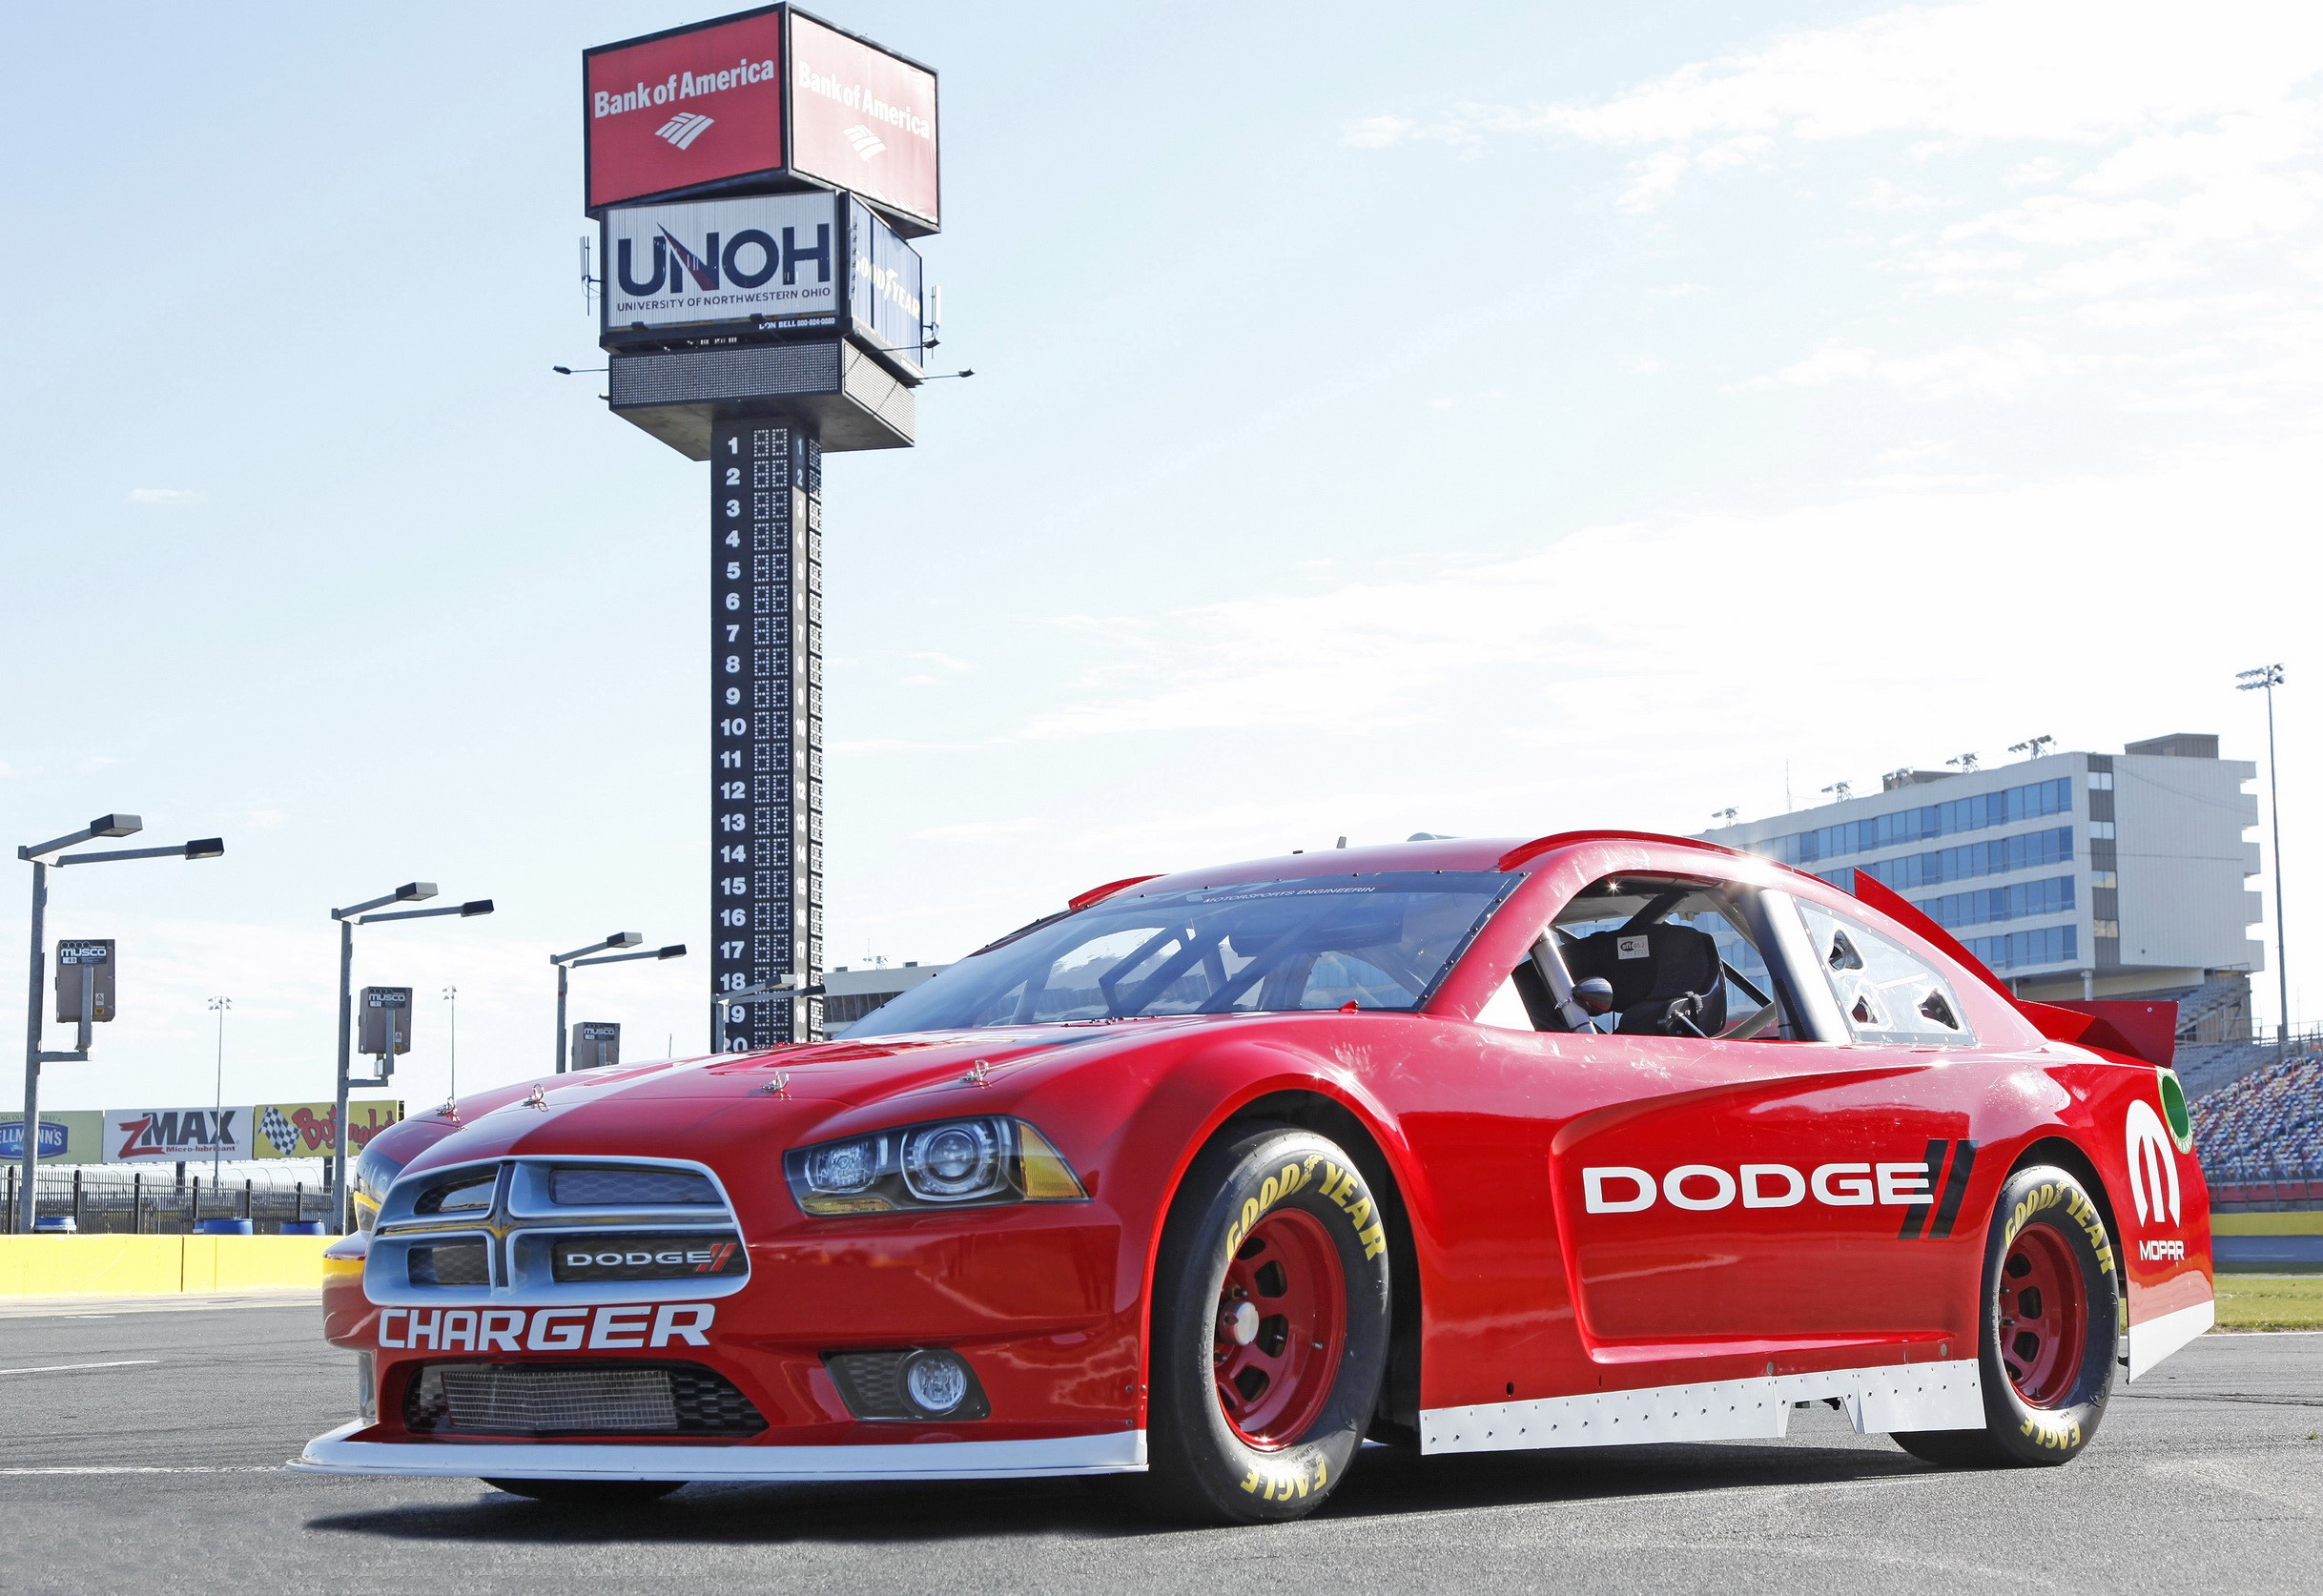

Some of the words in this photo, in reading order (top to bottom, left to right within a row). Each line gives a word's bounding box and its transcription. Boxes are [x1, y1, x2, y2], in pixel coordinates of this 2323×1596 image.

[594, 83, 651, 118] Bank
[653, 73, 677, 105] of
[680, 58, 774, 98] America
[798, 61, 842, 102] Bank
[843, 84, 861, 110] of
[862, 88, 931, 139] America
[617, 222, 831, 297] UNOH
[617, 297, 685, 313] UNIVERSITY
[687, 296, 702, 307] OF
[702, 290, 799, 306] NORTHWESTERN
[801, 287, 832, 299] OHIO
[728, 436, 738, 455] 1
[796, 437, 804, 456] 1
[726, 467, 741, 486] 2
[796, 467, 804, 487] 2
[726, 499, 741, 518] 3
[796, 499, 805, 519] 3
[725, 529, 741, 548] 4
[796, 530, 804, 549] 4
[726, 561, 741, 580] 5
[796, 562, 804, 581] 5
[725, 592, 741, 611] 6
[796, 592, 804, 611] 6
[726, 624, 740, 643] 7
[797, 624, 804, 643] 7
[725, 655, 741, 674] 8
[796, 655, 804, 674] 8
[726, 686, 741, 706] 9
[796, 686, 804, 706] 9
[720, 717, 747, 736] 10
[795, 717, 807, 738] 10
[720, 749, 742, 768] 11
[795, 749, 805, 769] 11
[720, 781, 746, 800] 12
[795, 781, 807, 801] 12
[720, 812, 746, 832] 13
[795, 812, 807, 833] 13
[720, 844, 747, 864] 14
[795, 844, 807, 864] 14
[720, 876, 747, 895] 15
[795, 876, 807, 896] 15
[1203, 890, 1296, 904] MOTORSPORTS
[720, 908, 747, 927] 16
[795, 908, 807, 928] 16
[720, 940, 746, 959] 17
[795, 940, 806, 959] 17
[719, 972, 747, 992] 18
[1582, 1162, 1934, 1214] DODGE
[566, 1250, 712, 1266] DODGE
[2139, 1239, 2185, 1260] MOPAR
[378, 1303, 716, 1352] CHARGER
[2020, 1414, 2080, 1450] EAGLE
[1241, 1454, 1327, 1502] EAGLE
